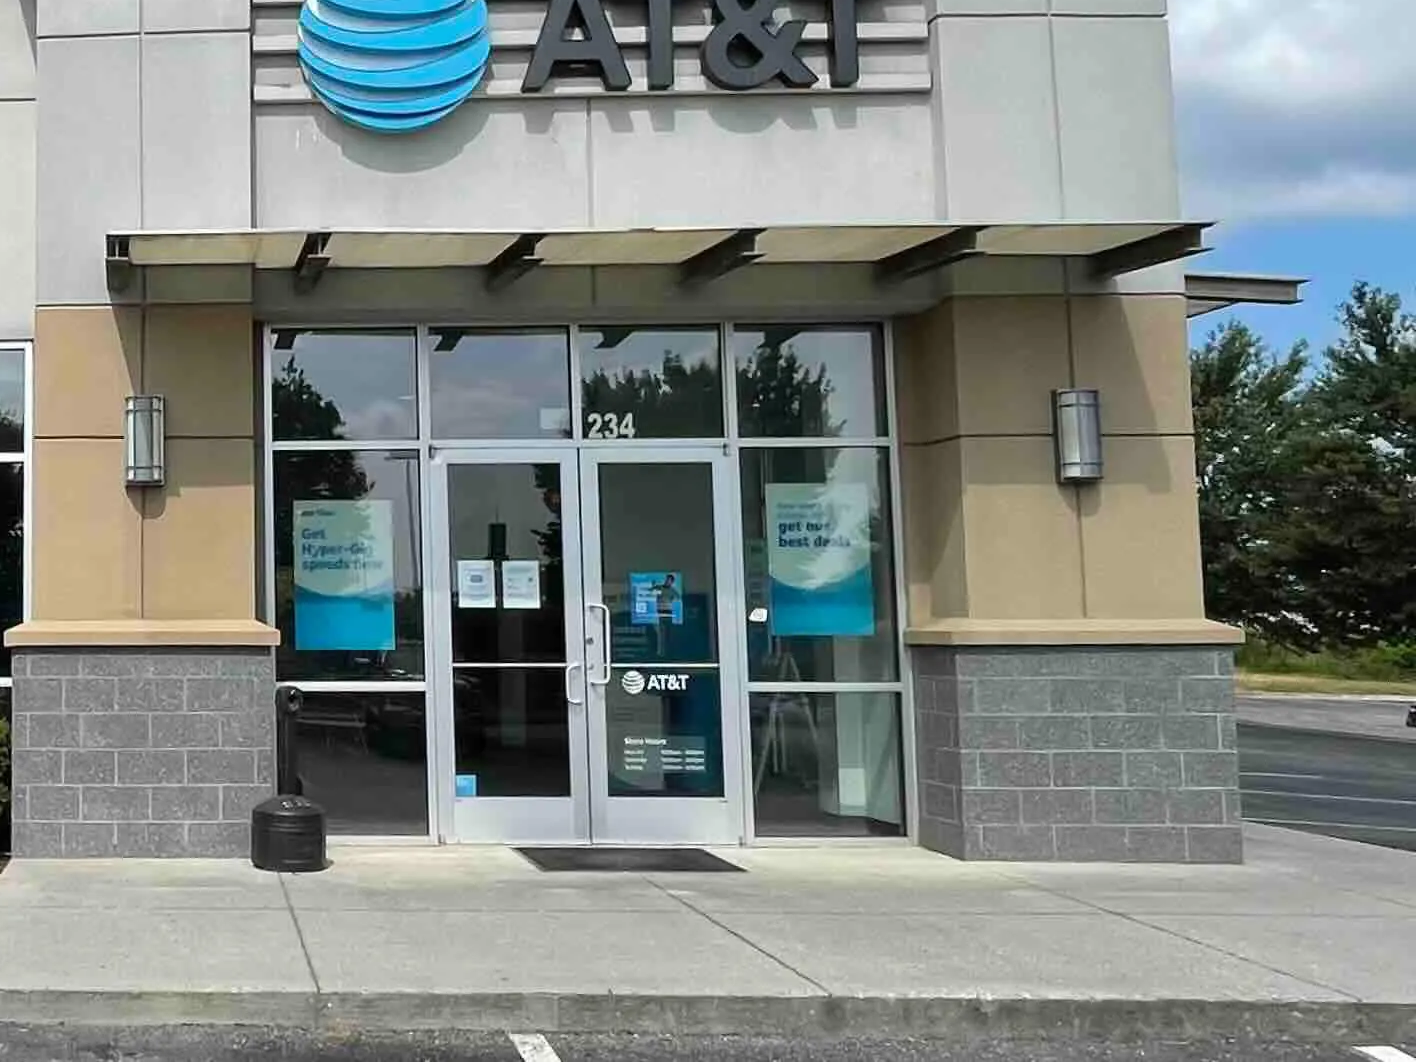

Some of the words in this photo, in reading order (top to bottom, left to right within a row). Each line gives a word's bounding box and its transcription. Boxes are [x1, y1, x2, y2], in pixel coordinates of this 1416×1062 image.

[587, 412, 636, 439] 234
[302, 528, 326, 540] Get
[779, 521, 801, 534] get
[779, 535, 810, 547] best
[302, 559, 350, 573] speeds
[647, 674, 690, 691] AT&T
